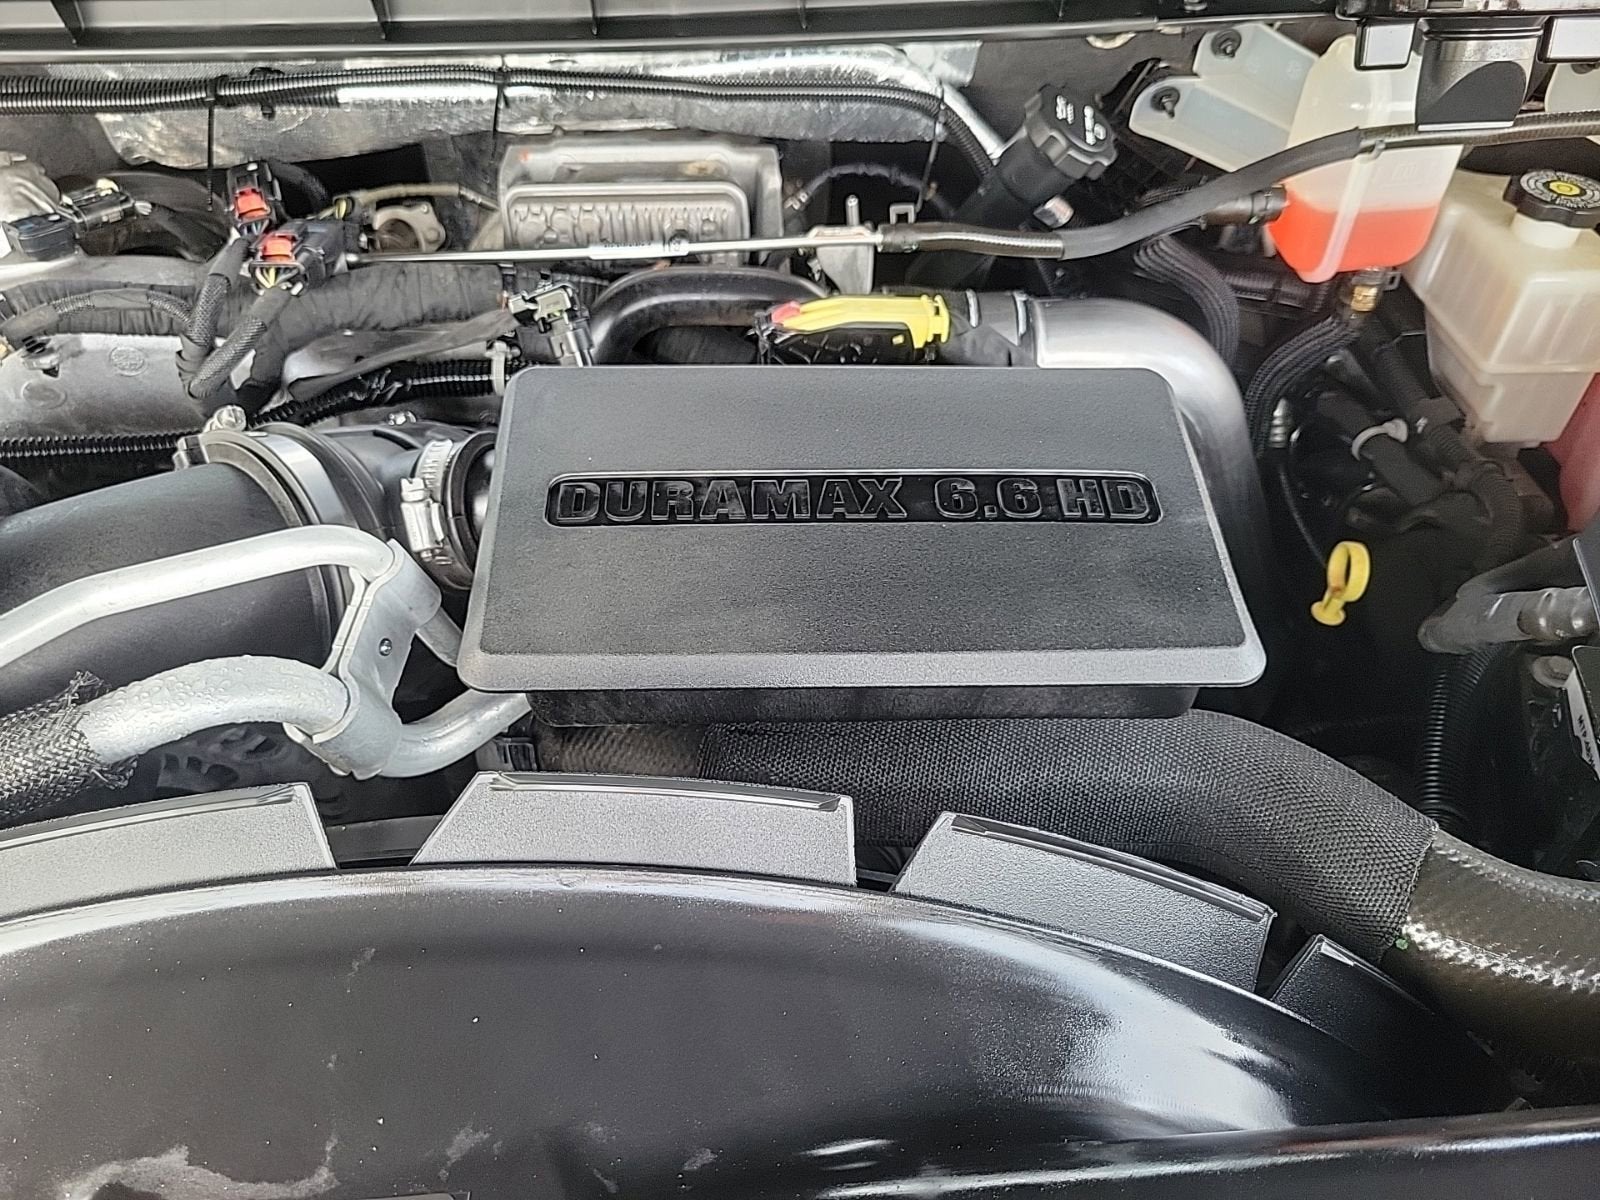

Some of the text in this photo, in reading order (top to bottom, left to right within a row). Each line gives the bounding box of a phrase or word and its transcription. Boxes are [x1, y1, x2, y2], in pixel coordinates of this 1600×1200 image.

[555, 477, 1154, 523] DURAMAX 6.6 HD
